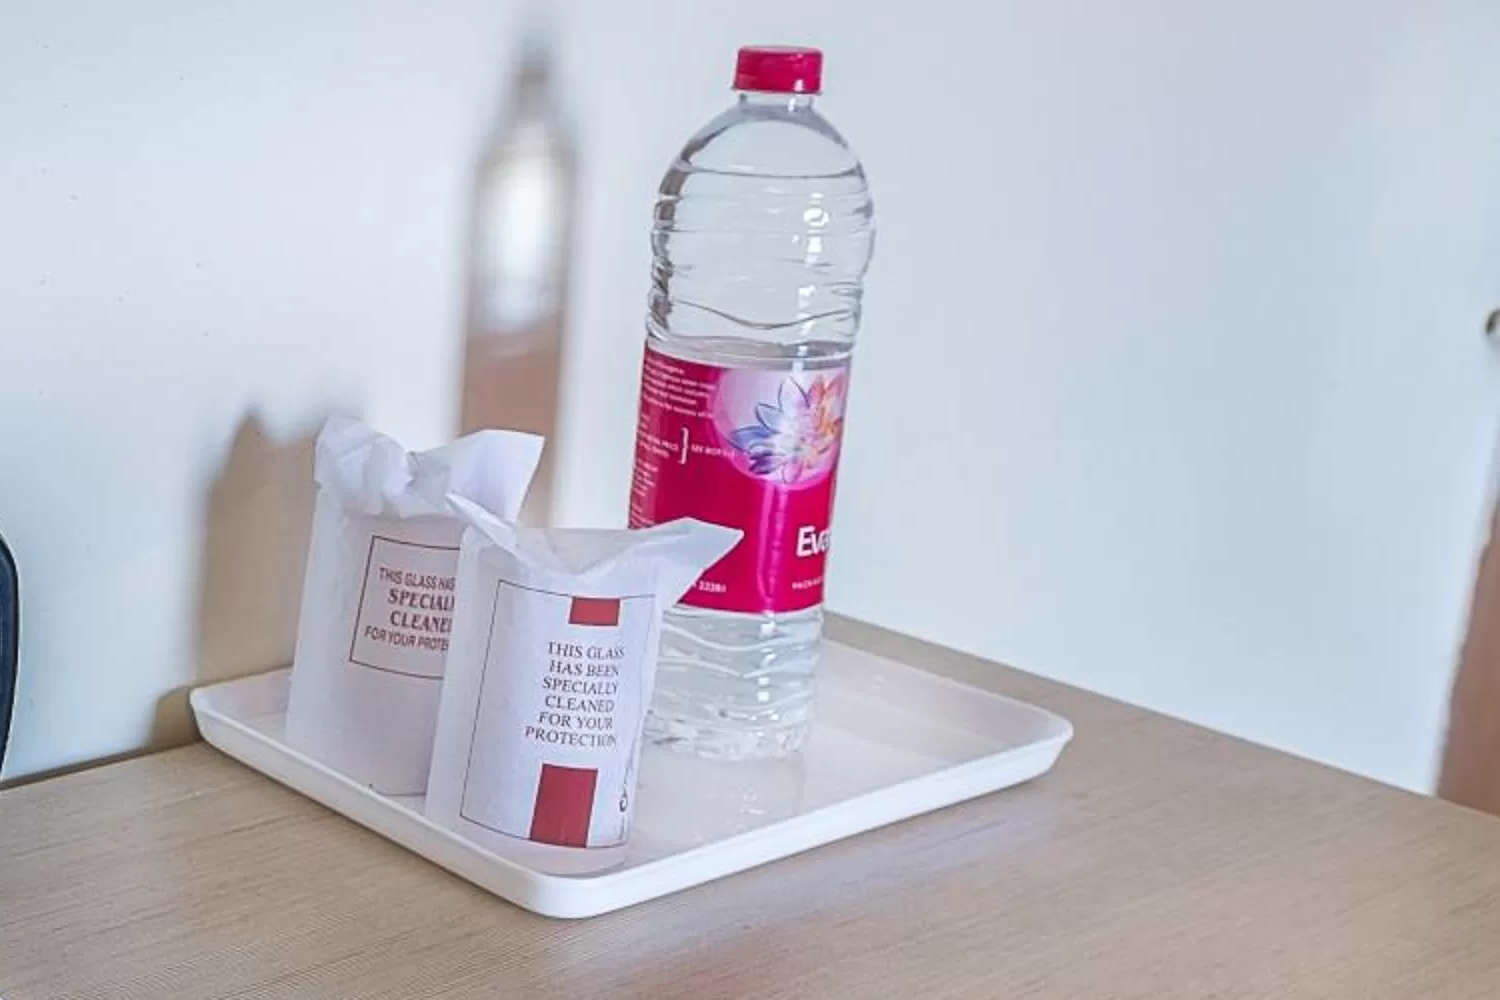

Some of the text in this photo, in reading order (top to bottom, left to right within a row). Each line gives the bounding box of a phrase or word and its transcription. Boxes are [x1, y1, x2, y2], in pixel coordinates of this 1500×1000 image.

[379, 567, 403, 585] THIS
[404, 572, 436, 589] GLASS
[364, 625, 386, 641] FOR
[388, 631, 417, 647] YOUR
[548, 642, 625, 660] THIS GLASS
[550, 660, 619, 677] HAS BEEN
[542, 676, 618, 695] SPECIALLY
[545, 695, 615, 713] CLEANED
[538, 712, 613, 730] FOR YOUR
[525, 726, 616, 747] PROTECTION
